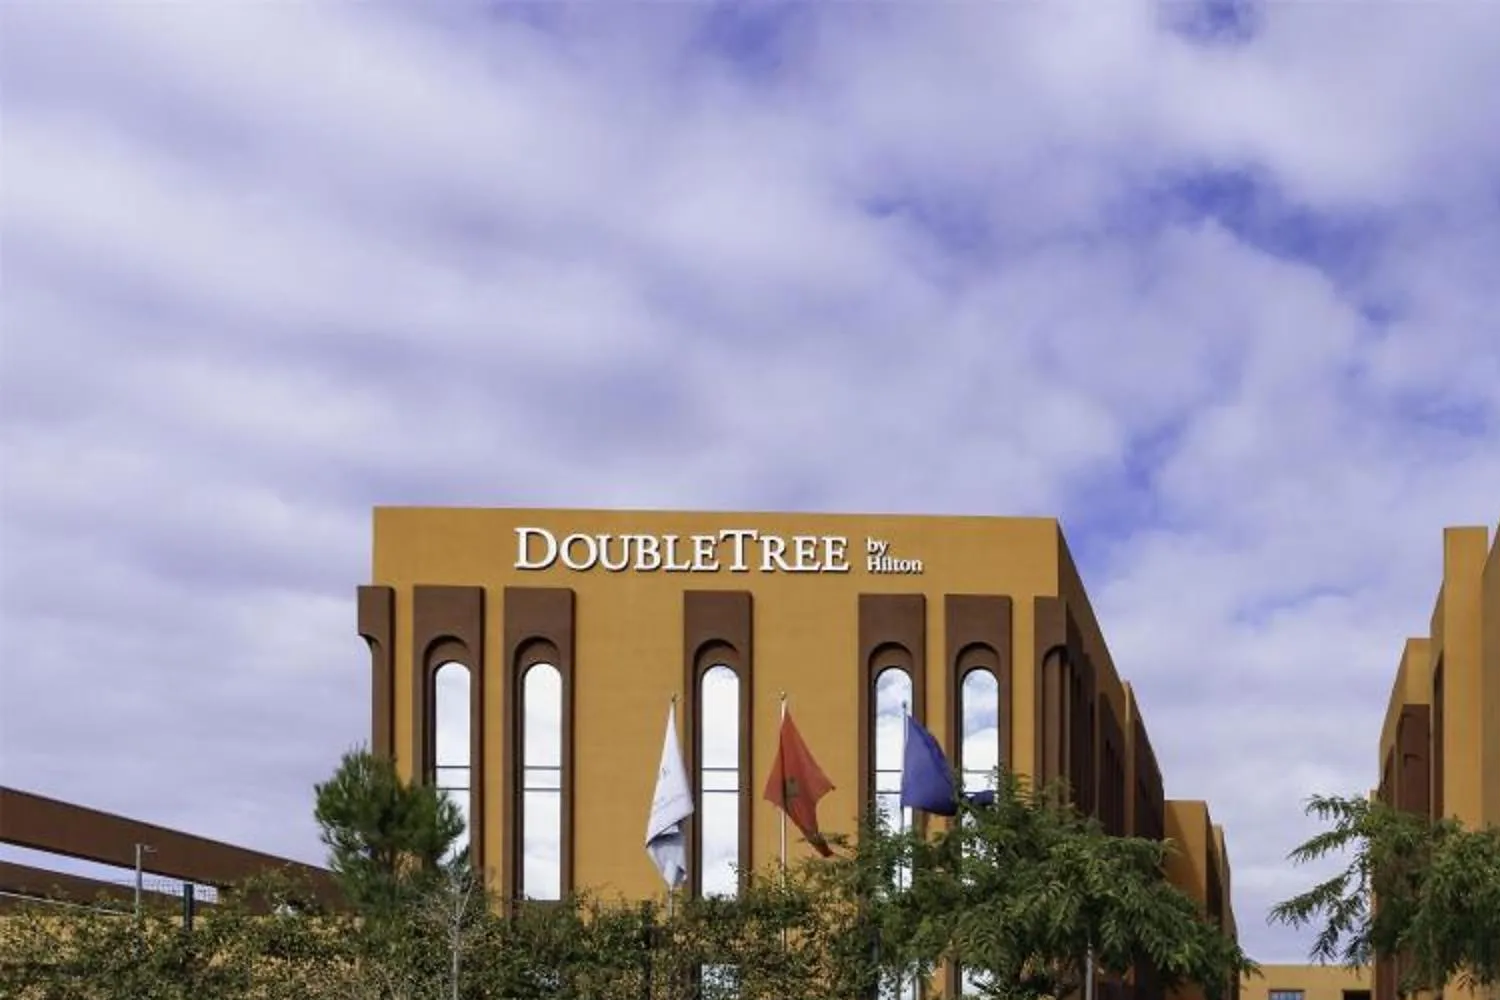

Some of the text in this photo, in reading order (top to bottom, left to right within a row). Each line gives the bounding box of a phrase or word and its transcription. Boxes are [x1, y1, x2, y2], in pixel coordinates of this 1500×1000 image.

[513, 527, 850, 572] DOUBLETREE
[867, 536, 888, 556] by
[867, 556, 923, 571] Hilton
